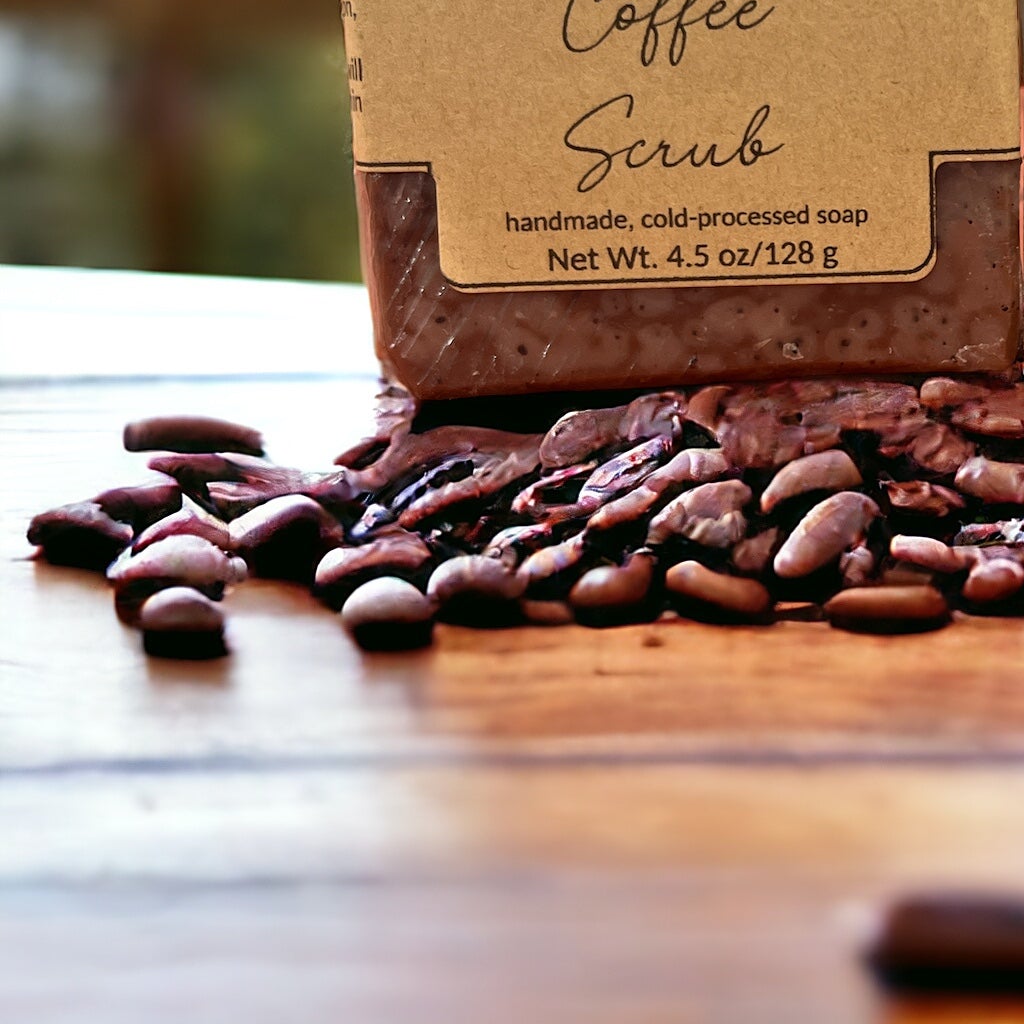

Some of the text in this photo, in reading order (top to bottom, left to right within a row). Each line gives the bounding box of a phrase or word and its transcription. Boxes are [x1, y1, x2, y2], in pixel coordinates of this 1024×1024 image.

[563, 93, 786, 194] Scrub
[505, 204, 869, 234] handmade, cold-processed soap
[547, 240, 839, 272] Net Wt. 4.5 oz/128 g
